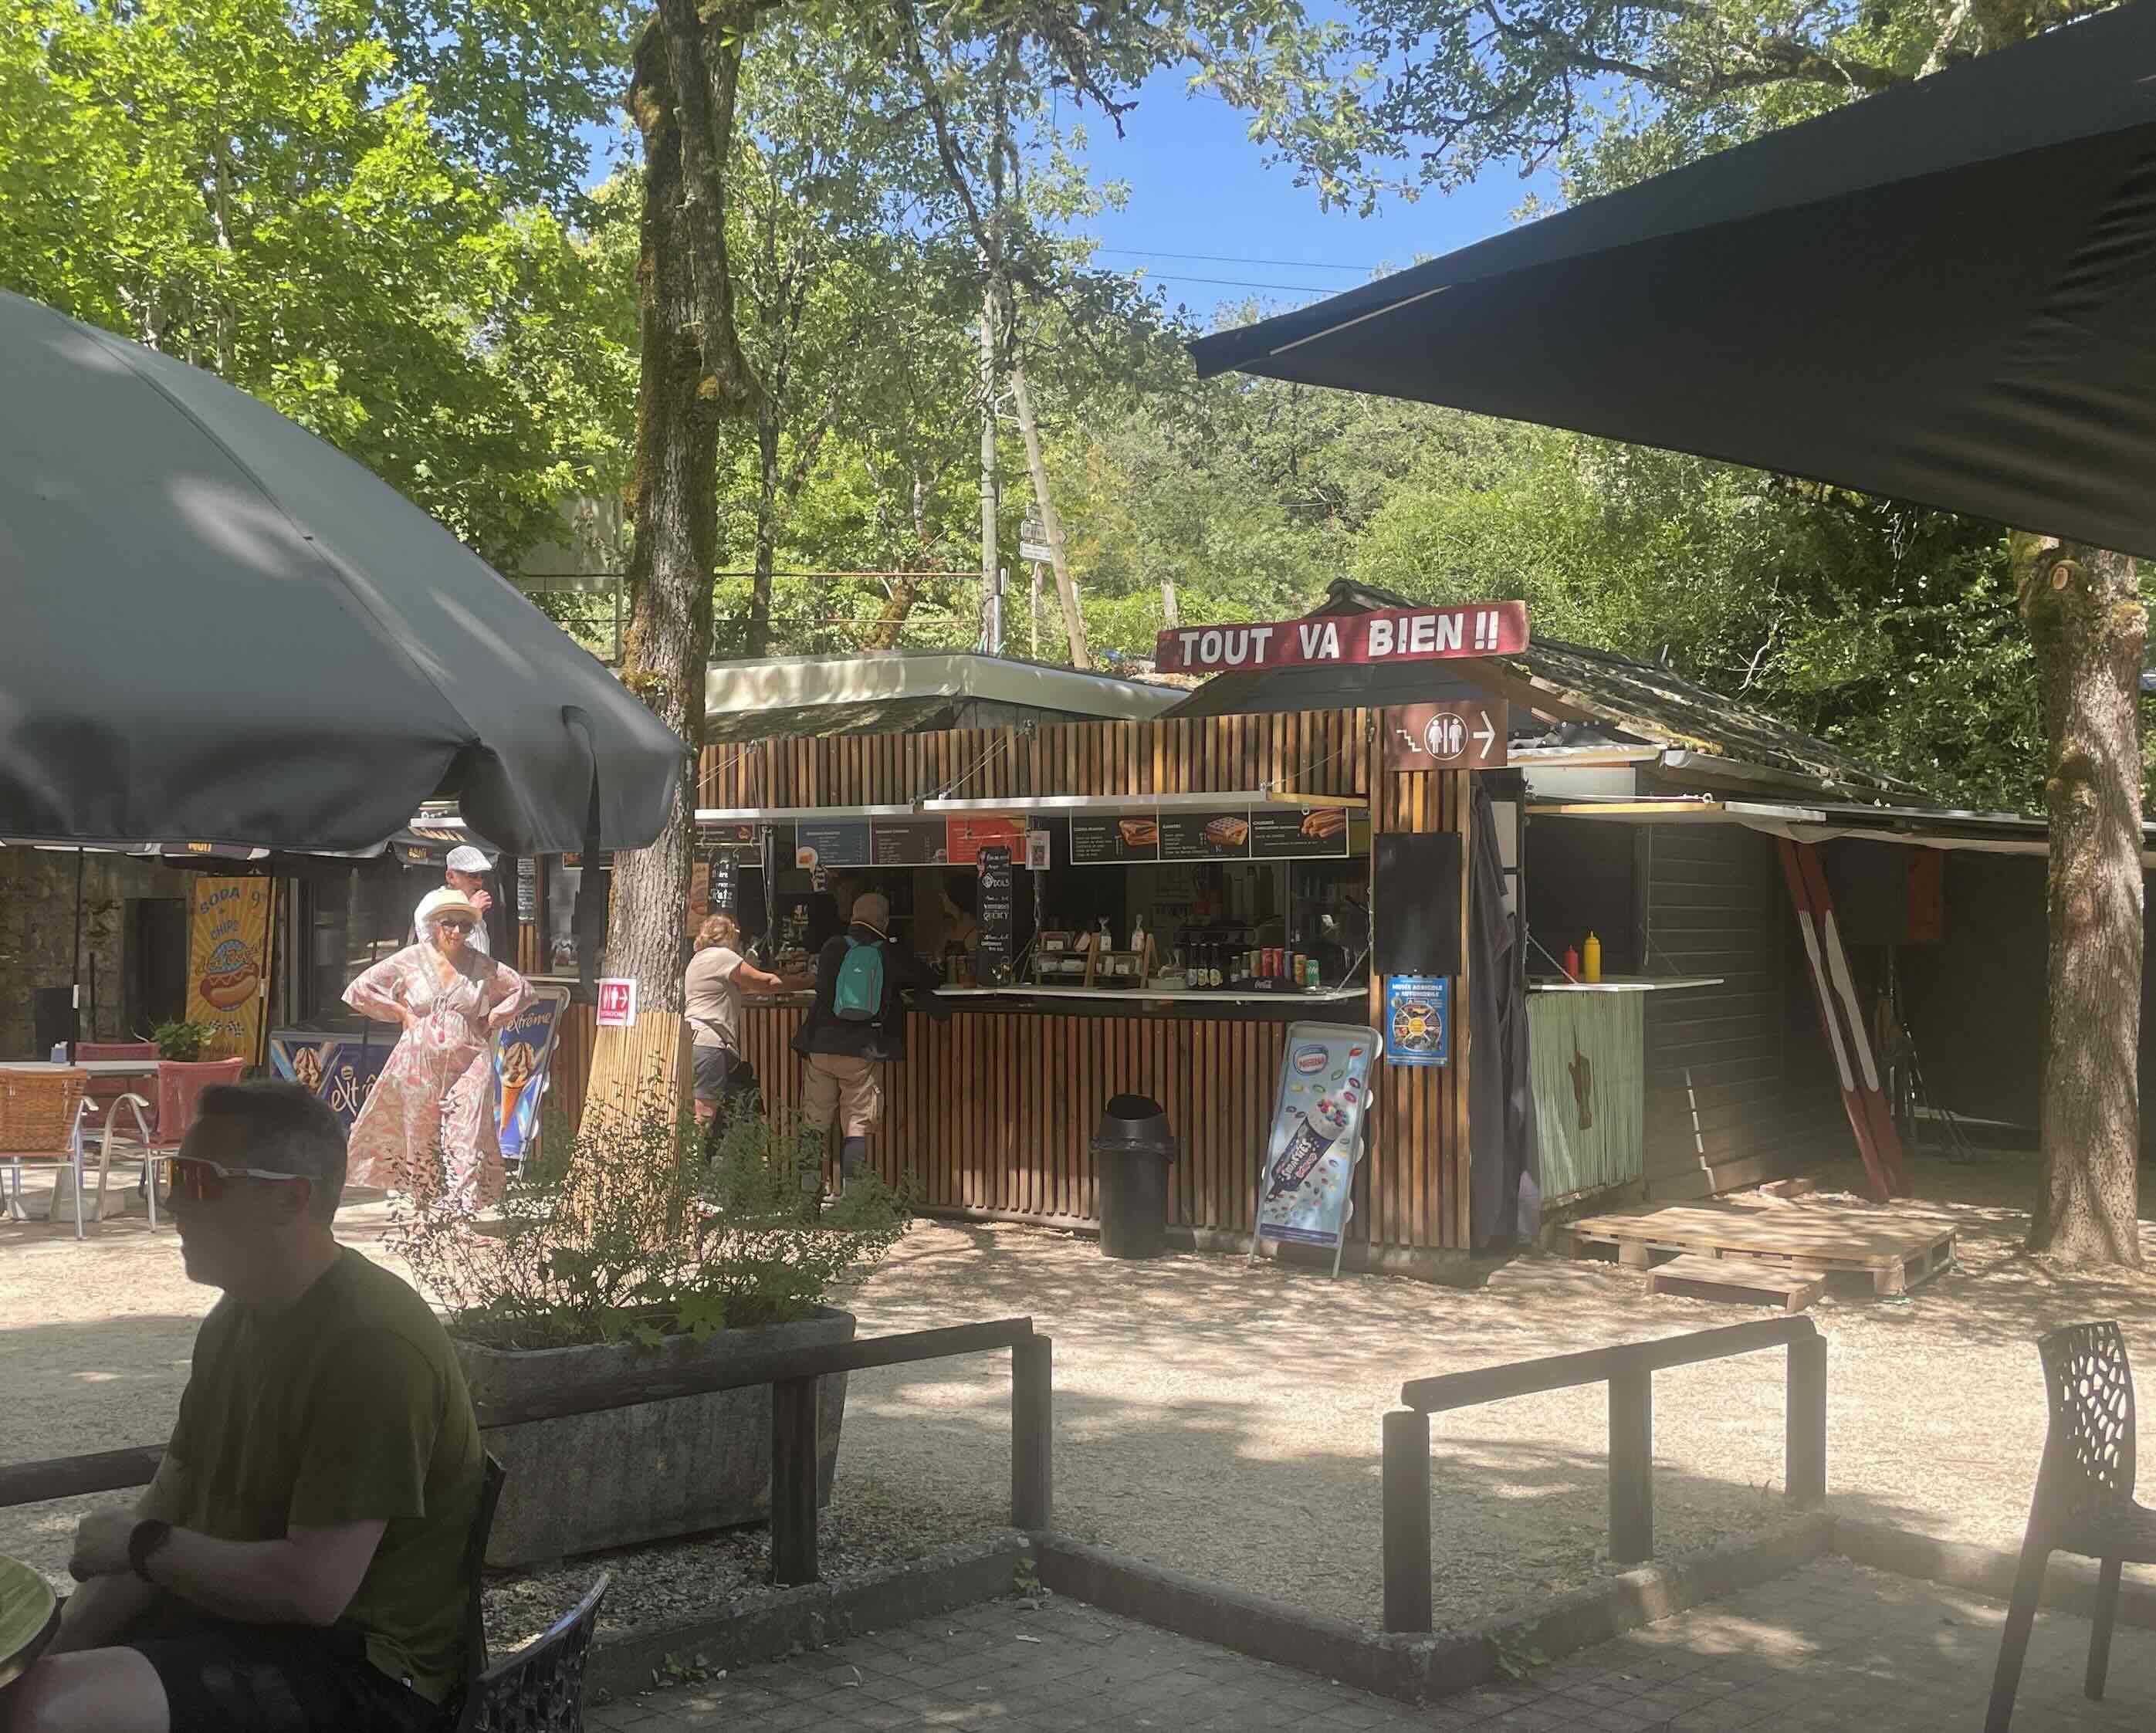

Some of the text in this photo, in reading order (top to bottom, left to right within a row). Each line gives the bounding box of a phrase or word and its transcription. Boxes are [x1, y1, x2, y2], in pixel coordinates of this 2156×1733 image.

[1179, 611, 1499, 666] TOUT VA BIEN !!
[200, 887, 240, 914] SODA
